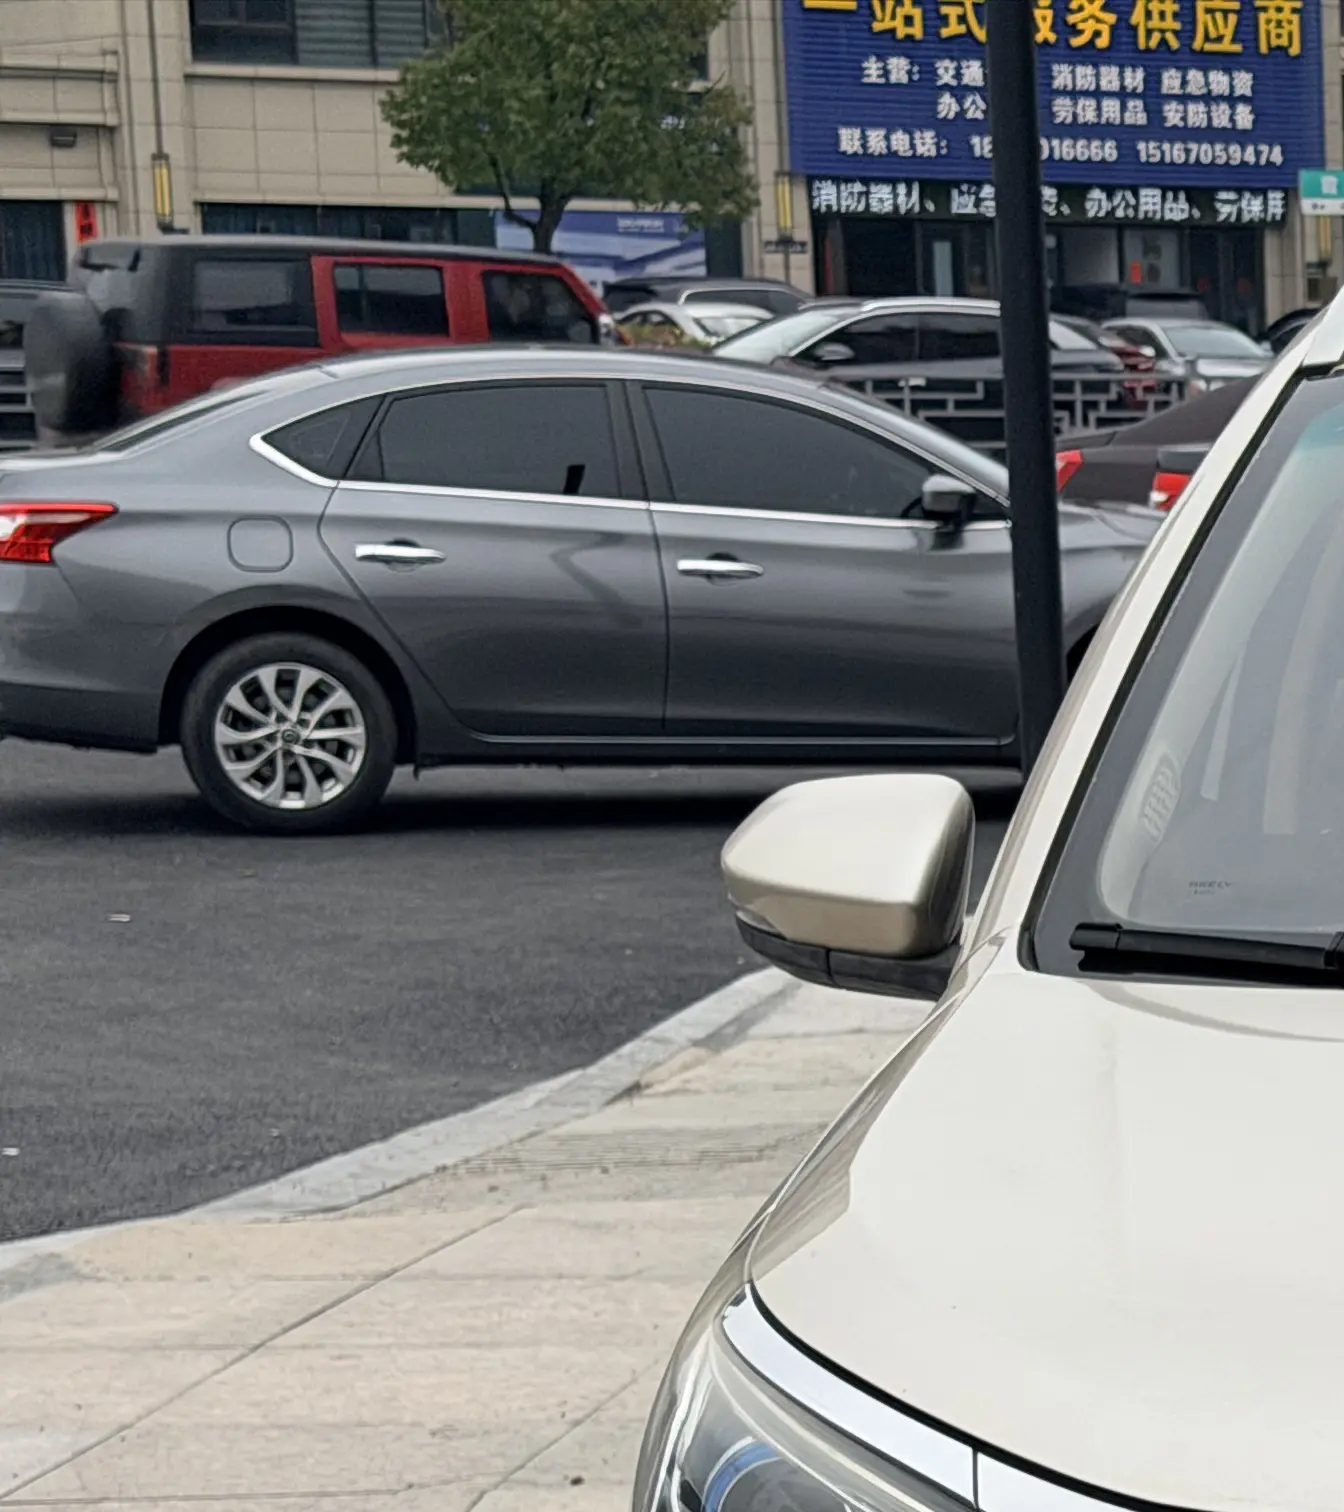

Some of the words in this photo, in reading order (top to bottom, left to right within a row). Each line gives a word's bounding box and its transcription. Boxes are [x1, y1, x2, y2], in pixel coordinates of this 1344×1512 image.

[1051, 63, 1145, 92] 消防器材
[1160, 68, 1254, 97] 应急物资
[1052, 96, 1148, 126] 劳保用品
[1163, 100, 1256, 130] 安防设备
[1136, 140, 1284, 167] 15167059474
